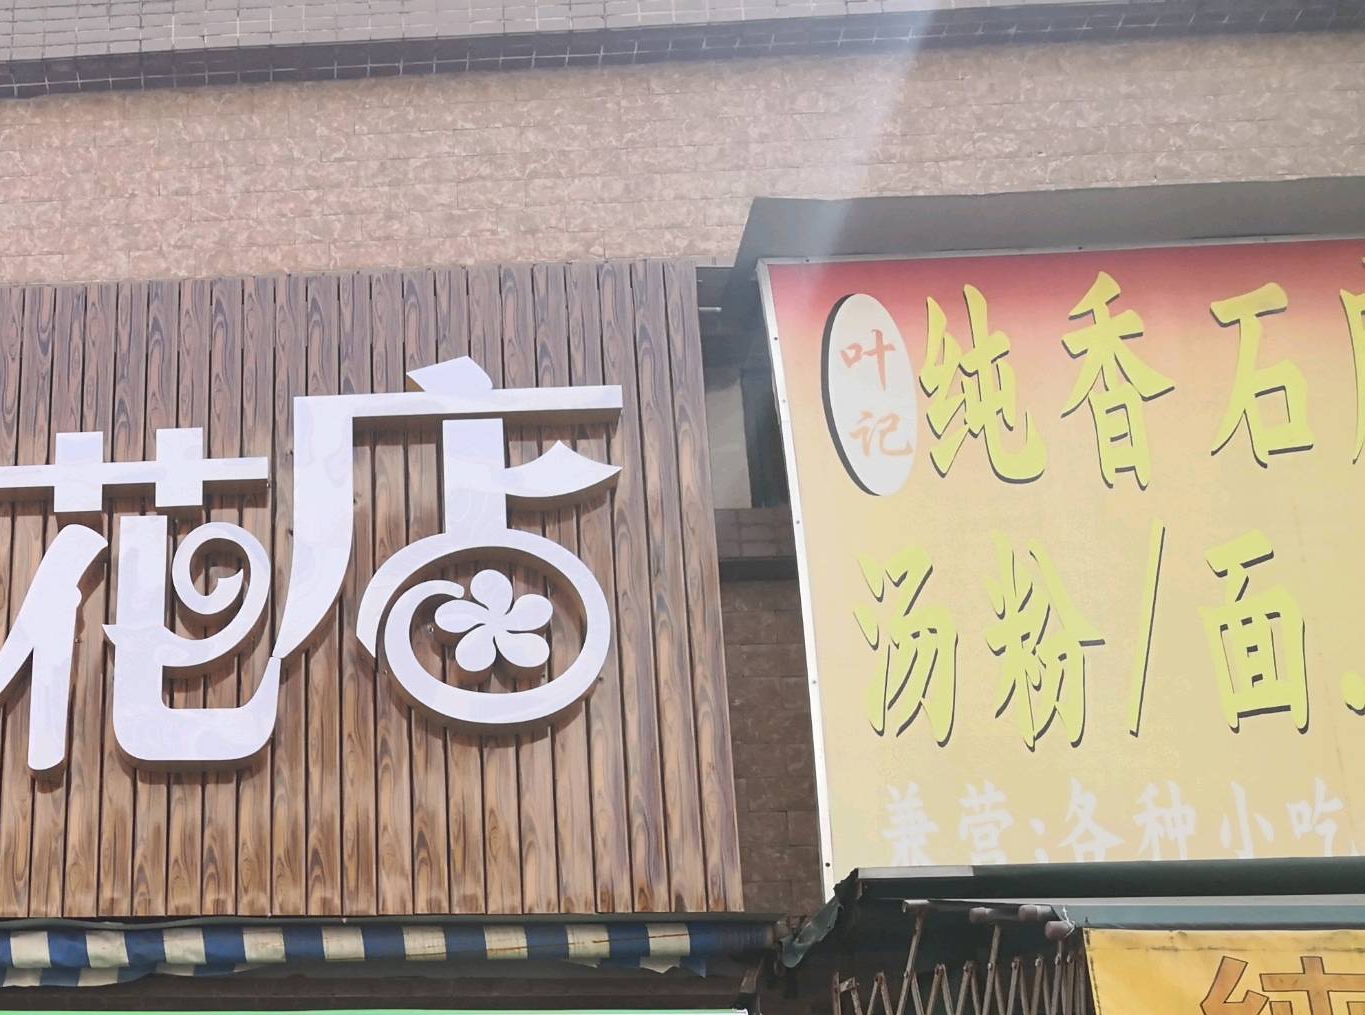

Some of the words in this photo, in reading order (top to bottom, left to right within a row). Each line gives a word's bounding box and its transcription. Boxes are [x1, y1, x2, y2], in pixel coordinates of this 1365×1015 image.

[840, 328, 914, 458] 叶记
[853, 518, 1365, 752] 汤粉/面
